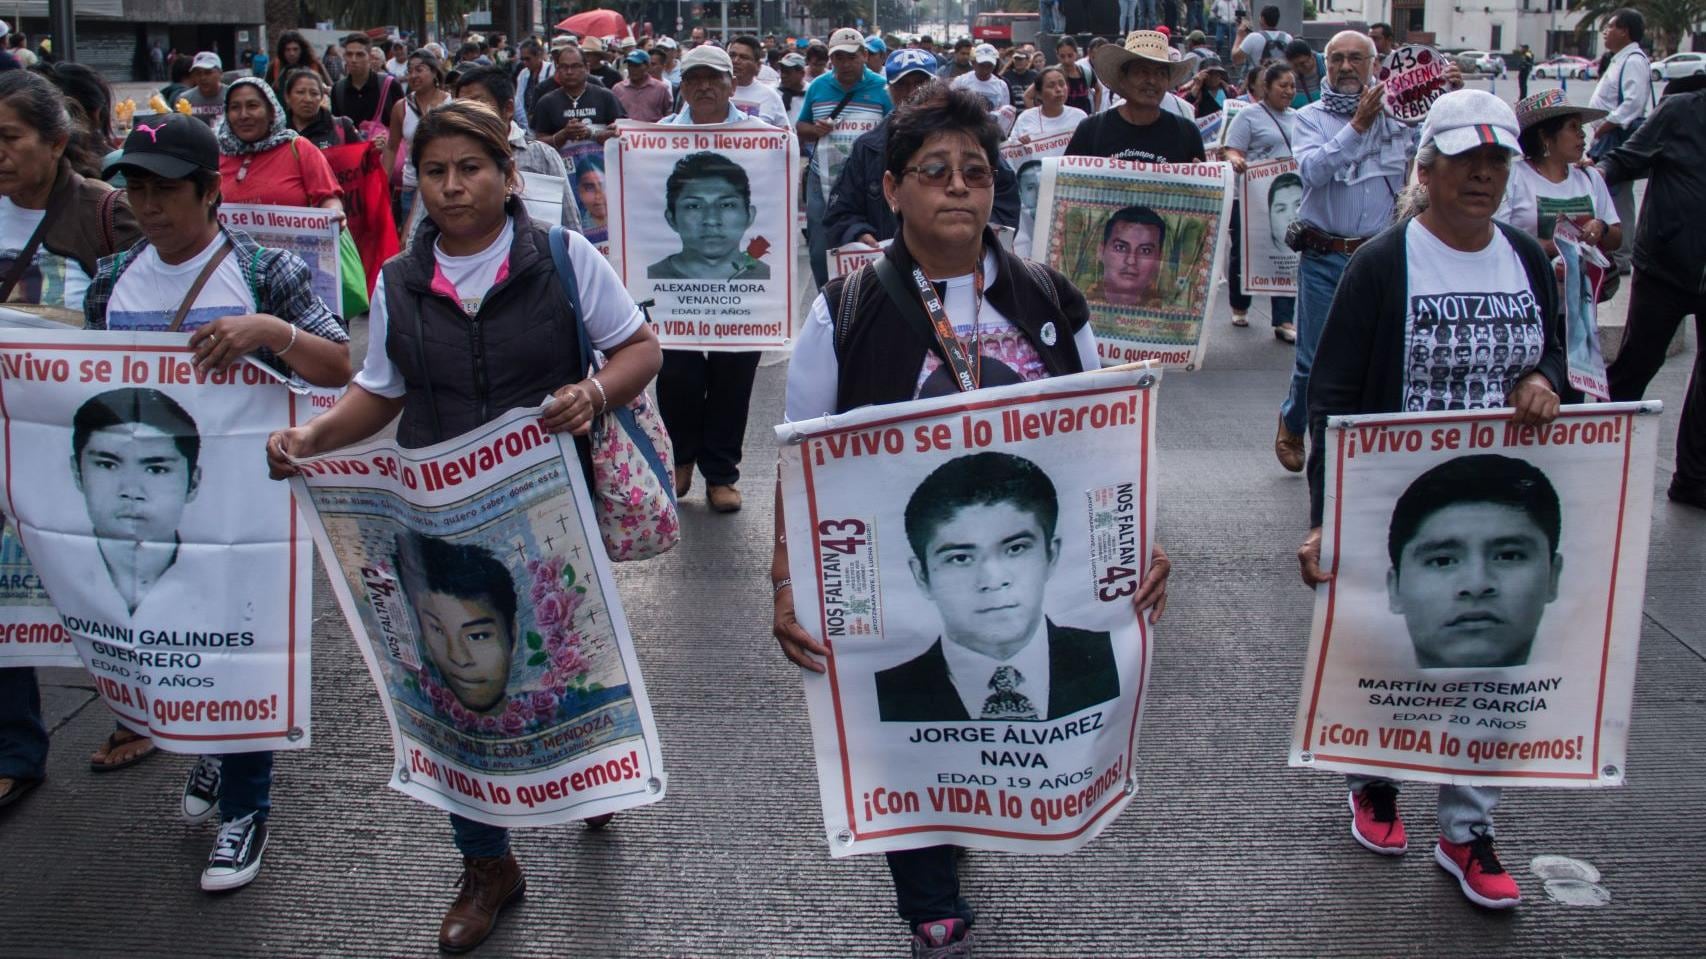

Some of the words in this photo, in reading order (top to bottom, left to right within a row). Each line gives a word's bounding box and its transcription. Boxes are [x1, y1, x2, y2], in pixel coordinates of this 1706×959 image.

[1390, 47, 1417, 73] 43
[1386, 59, 1443, 90] ESISTENCI
[576, 107, 596, 117] FALTAN
[834, 121, 857, 131] Vivo
[860, 121, 872, 130] se
[624, 133, 667, 151] ¡Vivo
[672, 135, 688, 149] se
[695, 133, 708, 149] lo
[714, 133, 784, 150] llevaron!
[1023, 145, 1033, 155] lo
[1111, 148, 1155, 159] yotzinapa
[1060, 157, 1104, 168] ¡Vivo
[1109, 158, 1126, 170] se
[1132, 160, 1146, 172] lo
[1248, 166, 1269, 182] ¡Vivo
[1270, 164, 1279, 177] se
[1280, 162, 1288, 173] lo
[232, 212, 248, 225] se
[253, 211, 264, 226] lo
[268, 212, 330, 230] llevaron!
[653, 283, 726, 293] ALEXANDER
[729, 283, 766, 293] MORA
[1251, 275, 1269, 286] ¡Con
[1271, 276, 1291, 286] VIDA
[671, 308, 701, 316] EDAD
[705, 308, 717, 316] 21
[720, 306, 751, 316] AÑOS
[677, 295, 742, 305] VENANCIO
[664, 321, 696, 337] VIDA
[699, 321, 713, 337] lo
[715, 321, 782, 340] queremos!
[1108, 343, 1121, 359] lo
[1124, 348, 1191, 364] queremos!
[79, 358, 112, 384] se
[122, 355, 149, 384] lo
[814, 427, 905, 466] ¡Vivo
[916, 425, 952, 453] se
[963, 415, 992, 449] lo
[1003, 395, 1138, 443] llevaron!
[1347, 425, 1423, 459] ¡Vivo
[1431, 425, 1461, 451] se
[1469, 422, 1494, 449] lo
[1503, 417, 1622, 448] llevaron!
[372, 456, 398, 481] se
[397, 457, 418, 490] lo
[420, 418, 552, 492] llevaron!
[481, 494, 505, 513] saber
[1116, 482, 1133, 513] NOS
[818, 518, 867, 555] 43
[1118, 515, 1136, 566] FALTAN
[0, 574, 44, 590] ARCI
[822, 552, 845, 605] FALTAN
[1098, 566, 1138, 602] 43
[371, 592, 398, 636] FALTAN
[826, 608, 846, 636] NOS
[0, 623, 73, 644] eremos
[63, 615, 134, 644] IOVANNI
[139, 630, 255, 648] GALINDES
[92, 640, 201, 669] GUERRERO
[386, 635, 403, 660] NOS
[91, 658, 130, 678] EDAD
[157, 674, 215, 688] AÑOS
[1442, 677, 1563, 696] GETSEMANY
[154, 695, 278, 726] queremos!
[1368, 692, 1467, 709] SÁNCHEZ
[1472, 696, 1548, 714] GARCÍA
[543, 713, 615, 752] MENDOZA
[909, 726, 996, 744] JORGE
[1003, 711, 1105, 745] ÁLVAREZ
[1392, 712, 1442, 722] EDAD
[1448, 715, 1471, 726] 20
[1476, 715, 1528, 730] AÑOS
[1319, 723, 1369, 747] ¡Con
[1379, 726, 1433, 755] VIDA
[1439, 731, 1460, 758] lo
[1467, 735, 1585, 764] queremos!
[981, 750, 1049, 769] NAVA
[409, 748, 442, 784] ¡Con
[444, 767, 487, 802] VIDA
[489, 781, 511, 806] lo
[516, 750, 641, 808] queremos!
[864, 786, 921, 822] ¡Con
[927, 786, 993, 817] VIDA
[999, 789, 1023, 819] lo
[1030, 754, 1125, 827] queremos!
[937, 772, 998, 786] EDAD
[1007, 776, 1031, 789] 19
[1039, 766, 1095, 790] AÑOS
